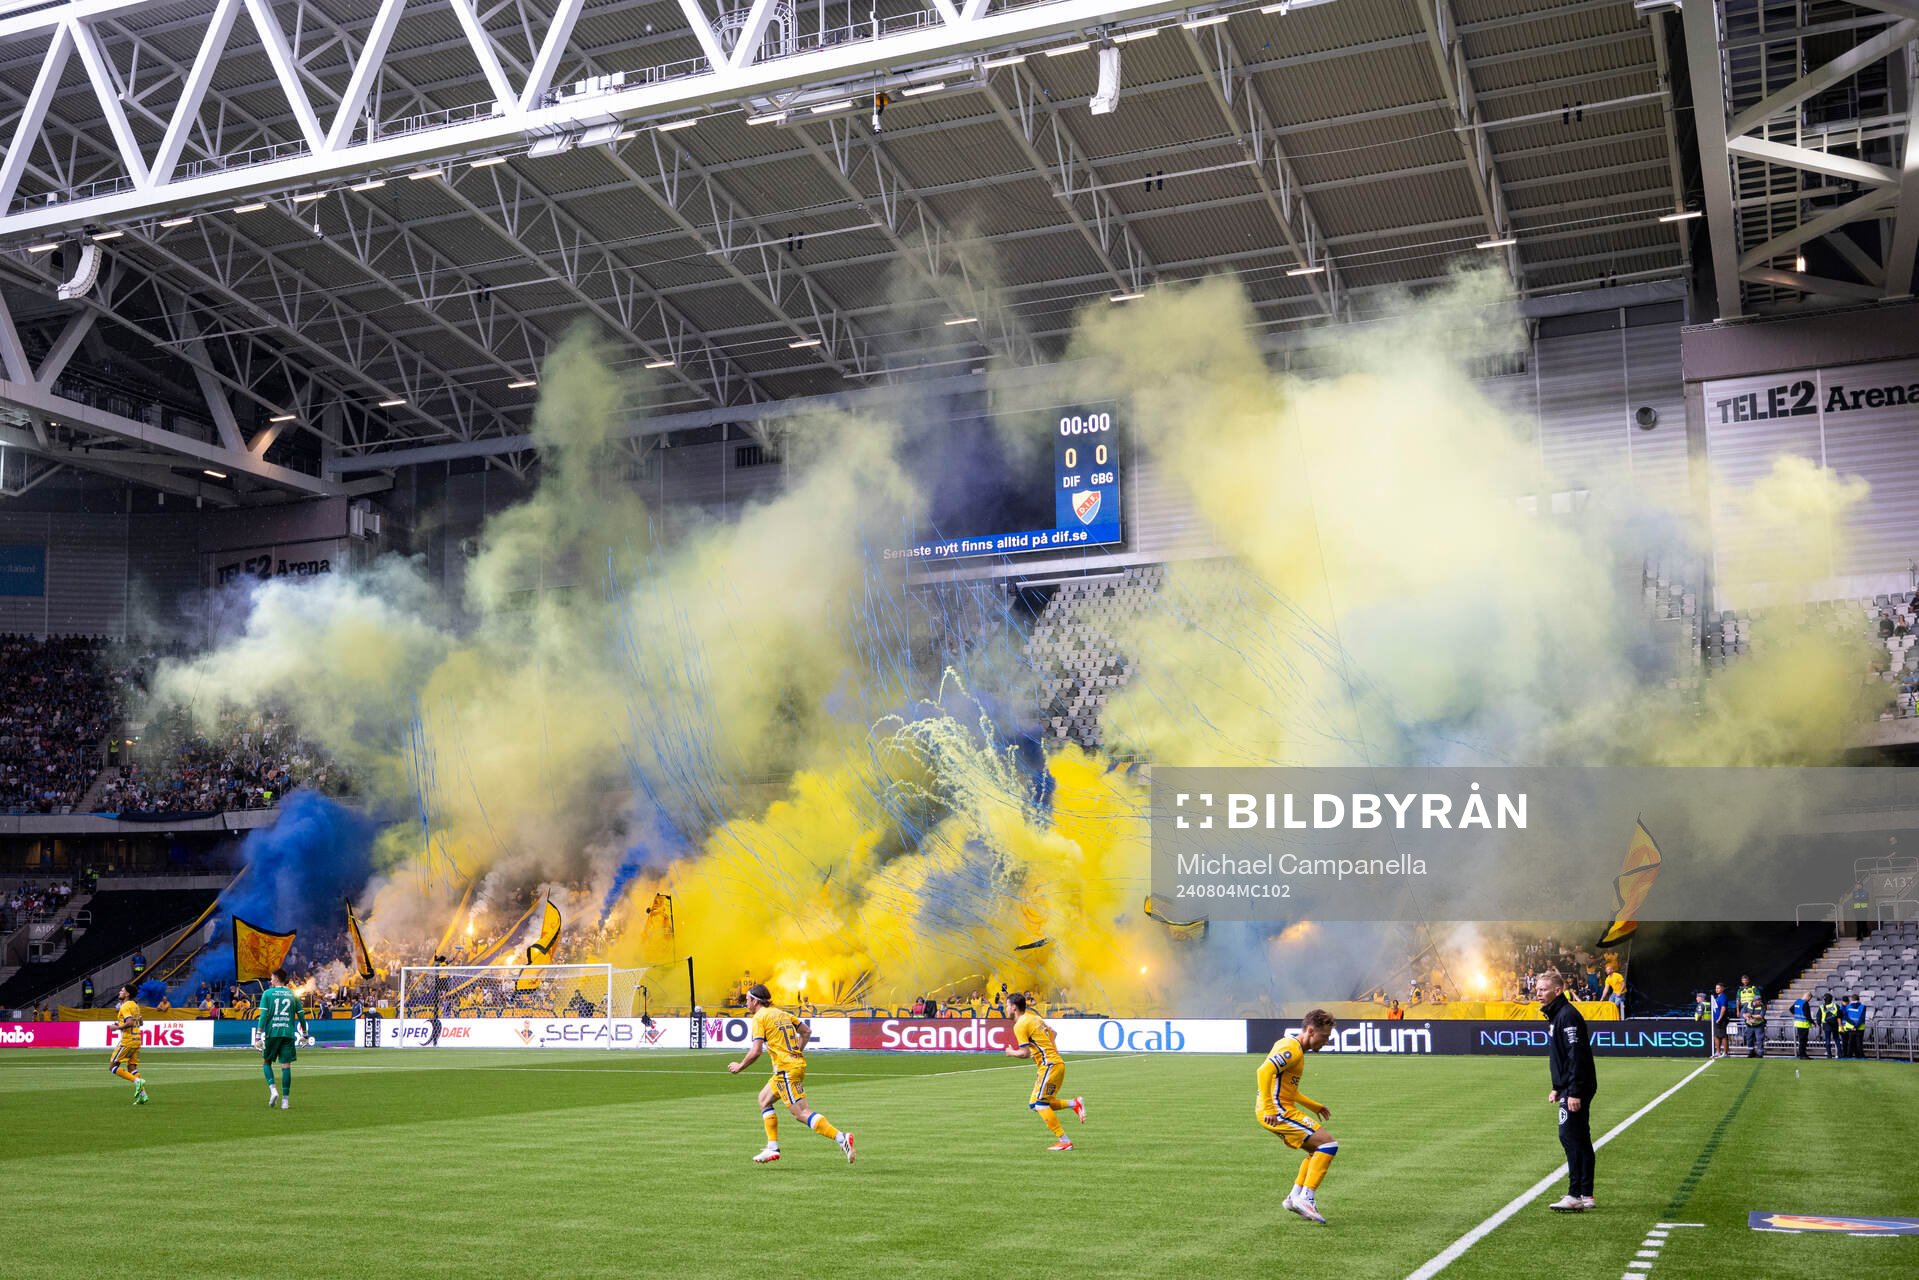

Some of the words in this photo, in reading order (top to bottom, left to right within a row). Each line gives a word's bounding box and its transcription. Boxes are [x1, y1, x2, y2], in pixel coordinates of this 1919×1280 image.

[1716, 381, 1817, 424] TELE2
[1060, 412, 1110, 436] 00:00
[1065, 447, 1077, 468] 0
[1095, 444, 1107, 465] 0
[1063, 475, 1081, 488] DIF
[1091, 472, 1114, 485] GBG
[883, 546, 931, 560] Senaste
[935, 542, 958, 556] nytt
[962, 540, 993, 552] finns
[997, 534, 1028, 549] alltid
[1032, 532, 1048, 548] på
[1052, 530, 1088, 544] dif.se
[274, 998, 291, 1016] 12
[546, 1024, 633, 1041] SEFAB
[691, 1017, 699, 1048] SELECT
[882, 1019, 1005, 1049] Scandic
[1098, 1020, 1185, 1051] Ocab
